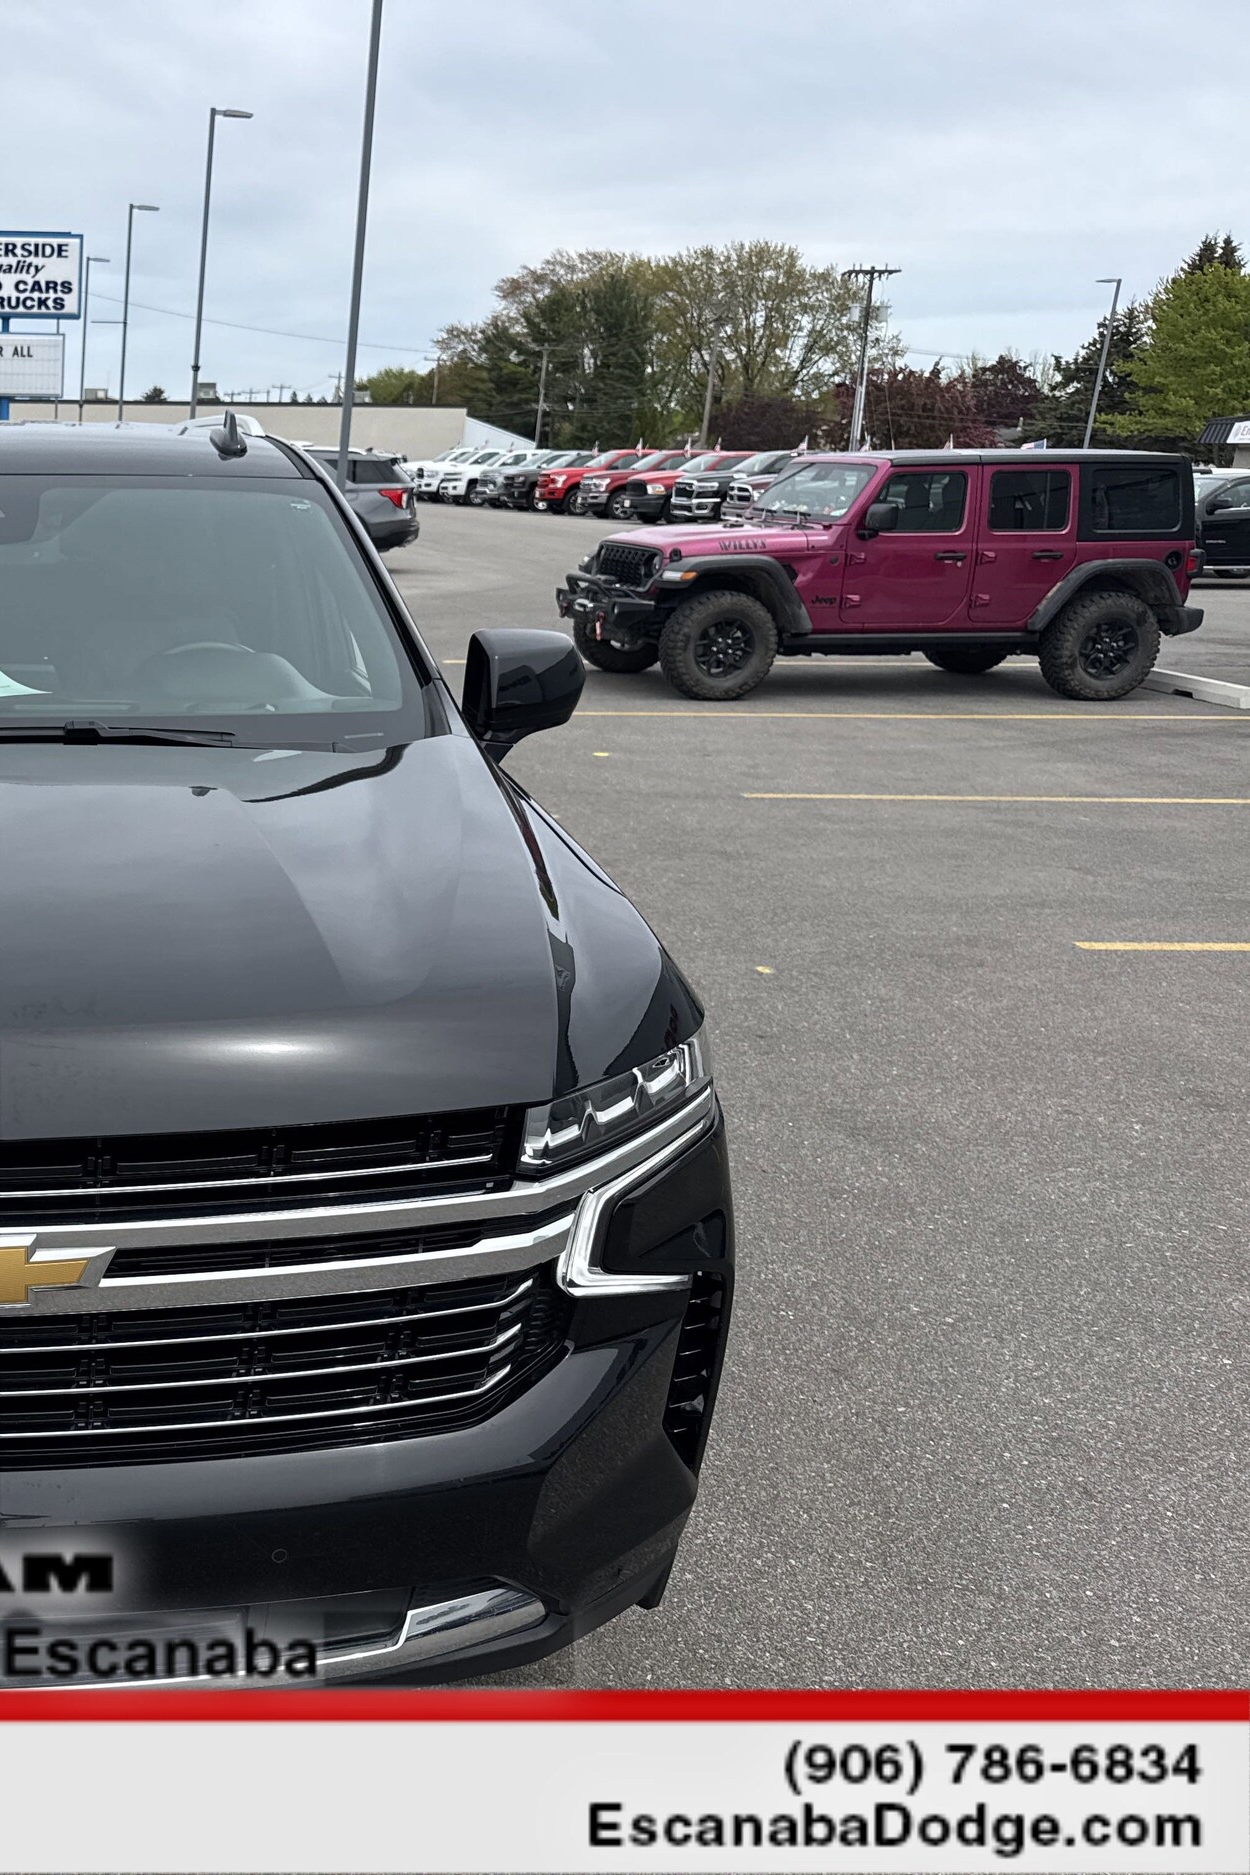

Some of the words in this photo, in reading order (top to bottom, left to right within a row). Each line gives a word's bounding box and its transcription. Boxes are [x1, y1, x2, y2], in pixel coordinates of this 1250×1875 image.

[14, 280, 73, 294] CARS
[12, 346, 33, 358] ALL
[718, 540, 767, 551] WILLYS
[811, 595, 837, 605] Jeep
